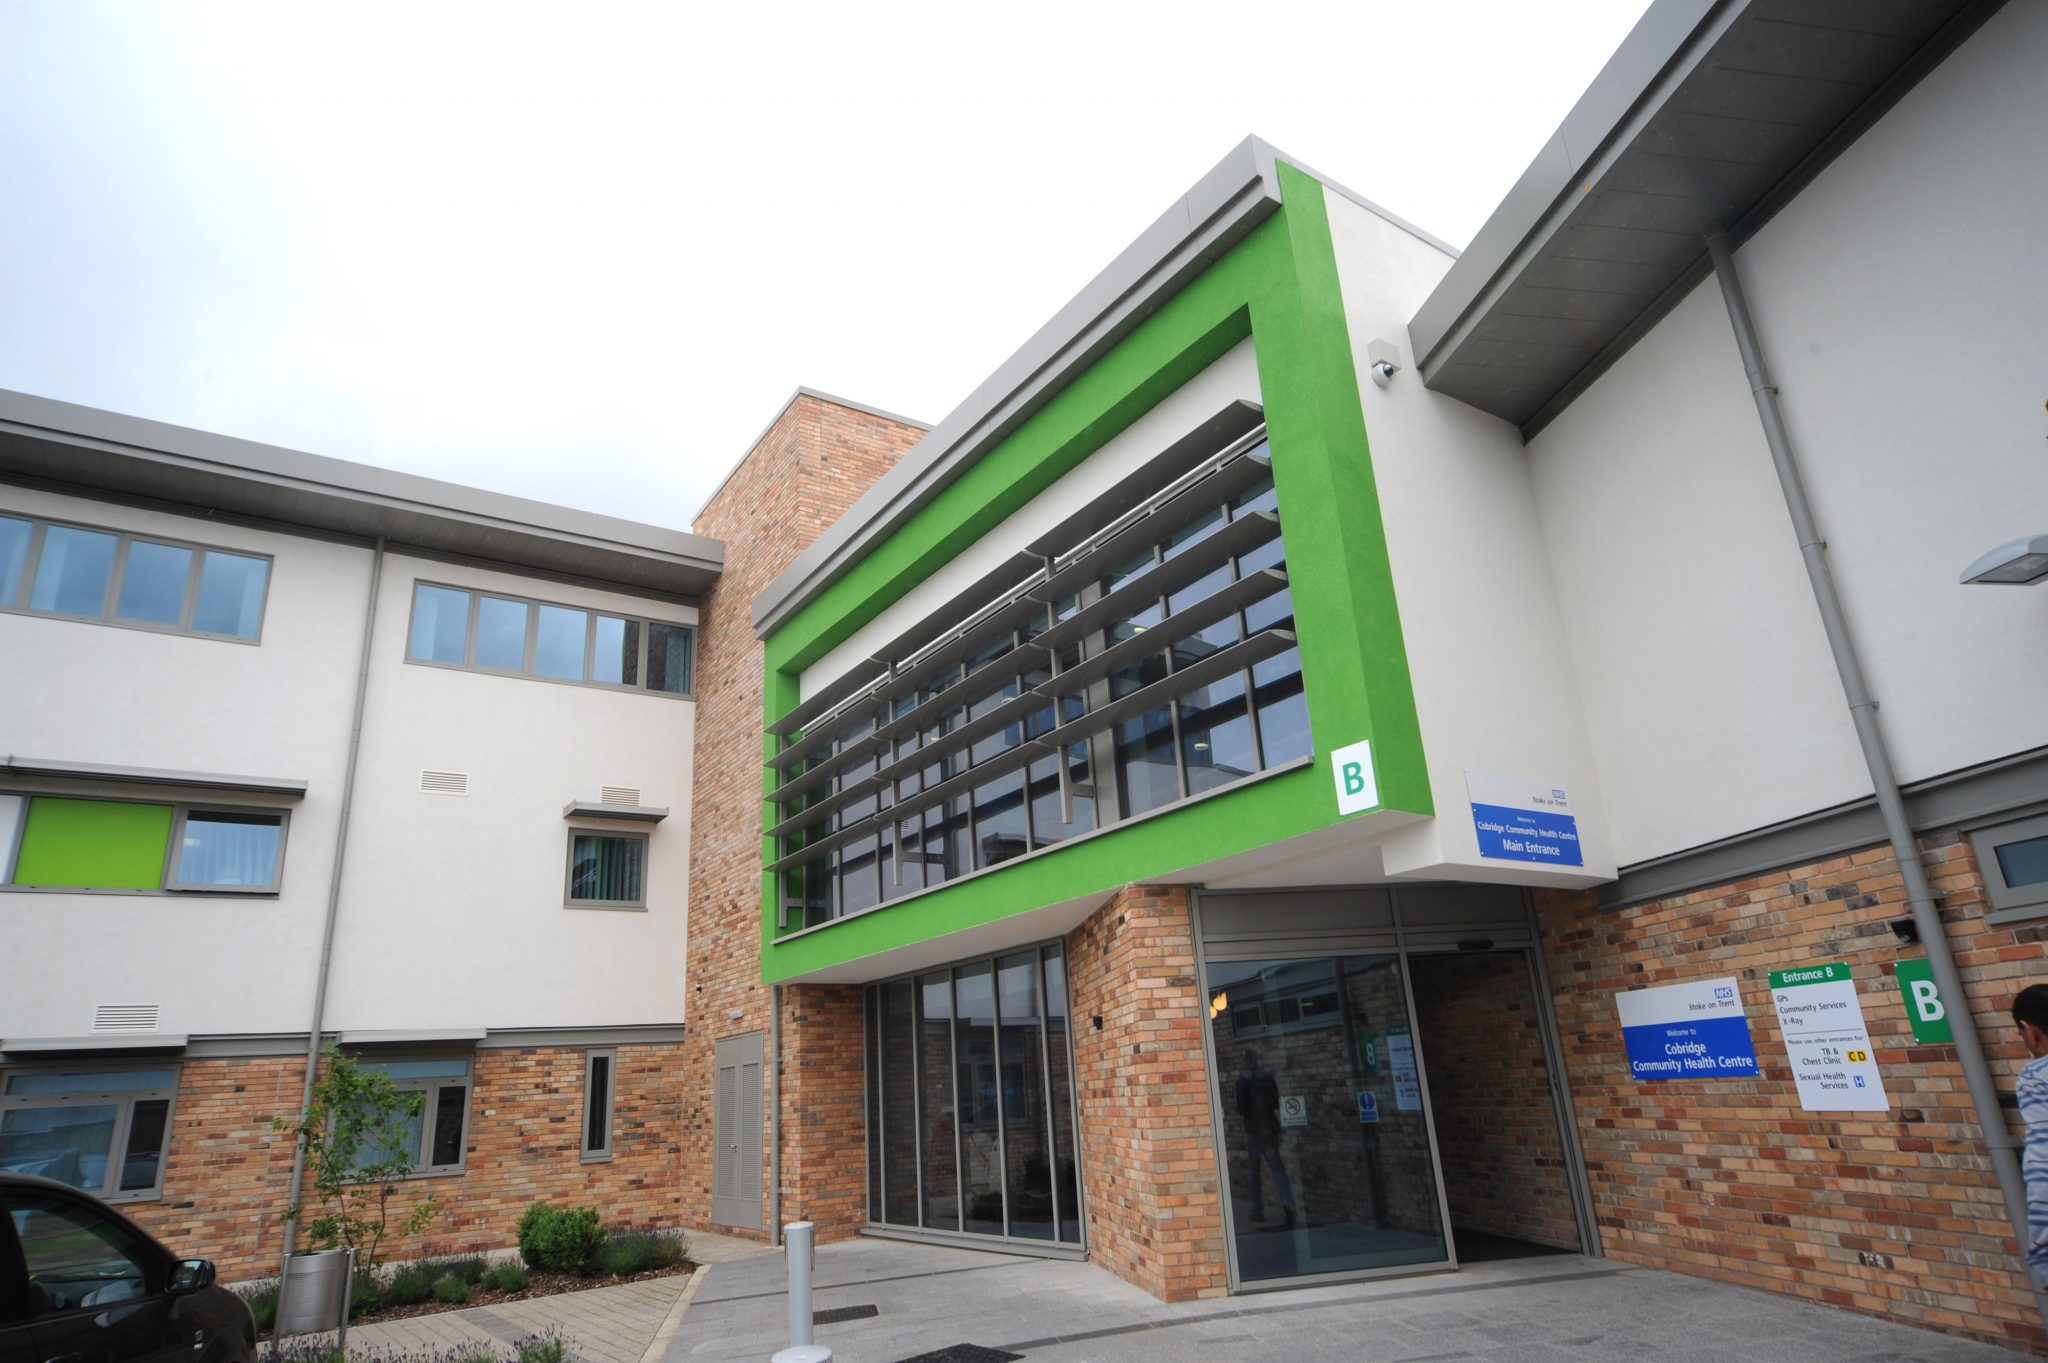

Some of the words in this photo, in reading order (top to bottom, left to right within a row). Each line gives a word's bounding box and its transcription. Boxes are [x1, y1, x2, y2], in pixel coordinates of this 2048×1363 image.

[1343, 761, 1364, 796] B
[1533, 796, 1546, 804] Stoke
[1555, 799, 1568, 807] Trent
[1477, 821, 1505, 834] Cobridge
[1506, 824, 1538, 838] Community
[1540, 829, 1558, 839] Health
[1558, 831, 1577, 841] Centre
[1502, 839, 1524, 852] Main
[1526, 841, 1560, 856] Entrance
[1782, 969, 1824, 983] Entrance
[1825, 966, 1834, 977] B
[1715, 988, 1733, 998] NHS
[1777, 995, 1789, 1003] GPs
[1910, 980, 1945, 1022] B
[1688, 1003, 1706, 1011] Stoke
[1718, 1000, 1735, 1008] Trent
[1780, 1003, 1817, 1014] Community
[1818, 1001, 1847, 1010] Services
[1783, 1017, 1803, 1026] X-Ray
[1666, 1028, 1688, 1037] Welcome
[1665, 1041, 1706, 1057] Cobridge
[1821, 1048, 1831, 1056] TB
[1833, 1047, 1839, 1055] &
[1802, 1058, 1822, 1066] Chest
[1823, 1056, 1843, 1065] Clinic
[1848, 1051, 1857, 1061] C
[1857, 1051, 1866, 1061] D
[1633, 1058, 1682, 1073] Community
[1684, 1056, 1716, 1070] Health
[1718, 1055, 1753, 1068] Centre
[1799, 1073, 1821, 1081] Sexual
[1823, 1072, 1847, 1080] Health
[1820, 1081, 1849, 1090] Services
